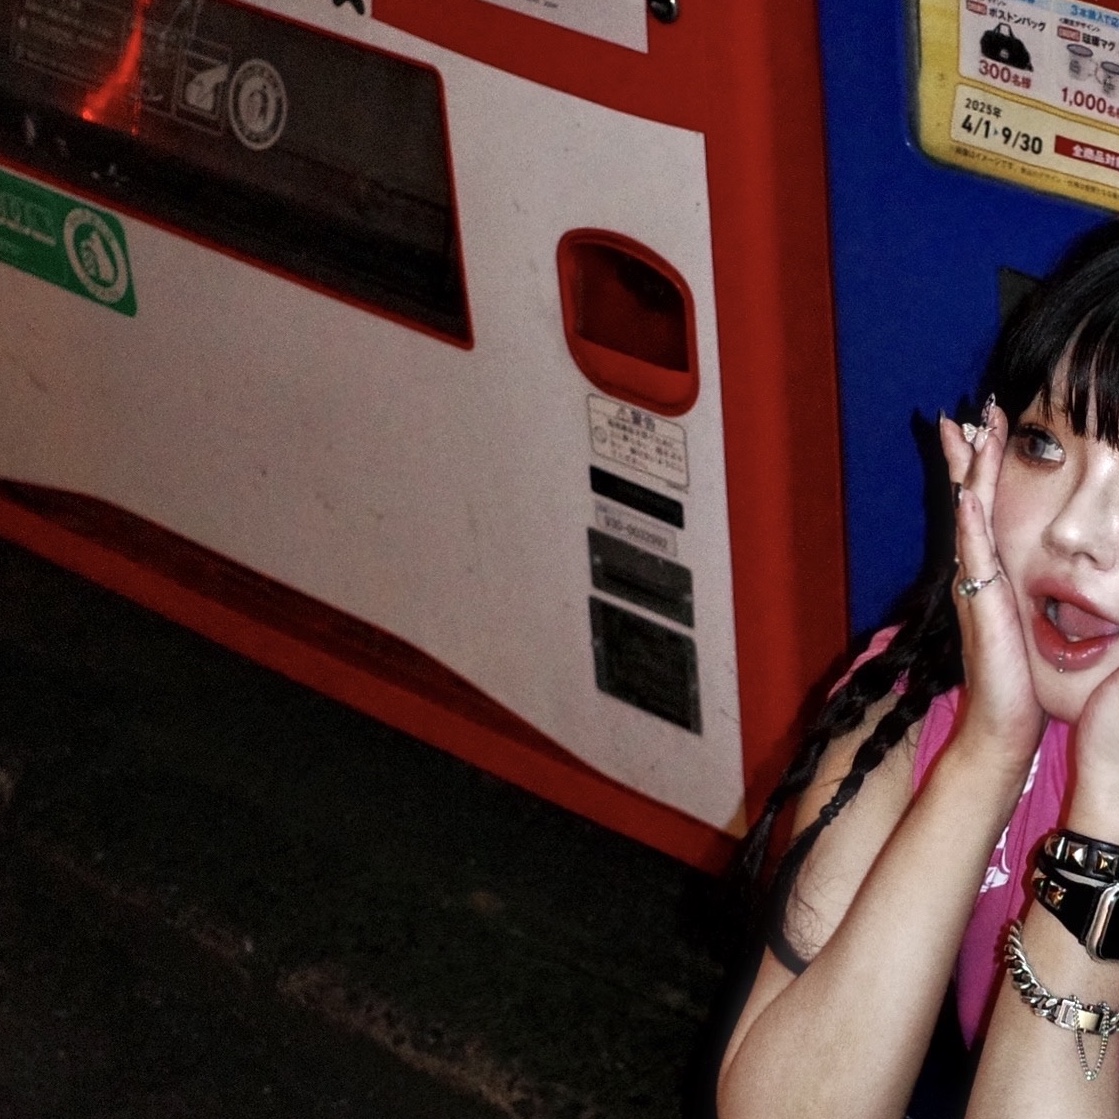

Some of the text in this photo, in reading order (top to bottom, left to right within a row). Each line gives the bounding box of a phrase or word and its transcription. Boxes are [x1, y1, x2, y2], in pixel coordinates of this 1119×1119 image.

[979, 60, 1032, 89] 300名様
[965, 98, 1002, 117] 2025年
[961, 114, 1043, 155] 4/1 9/30
